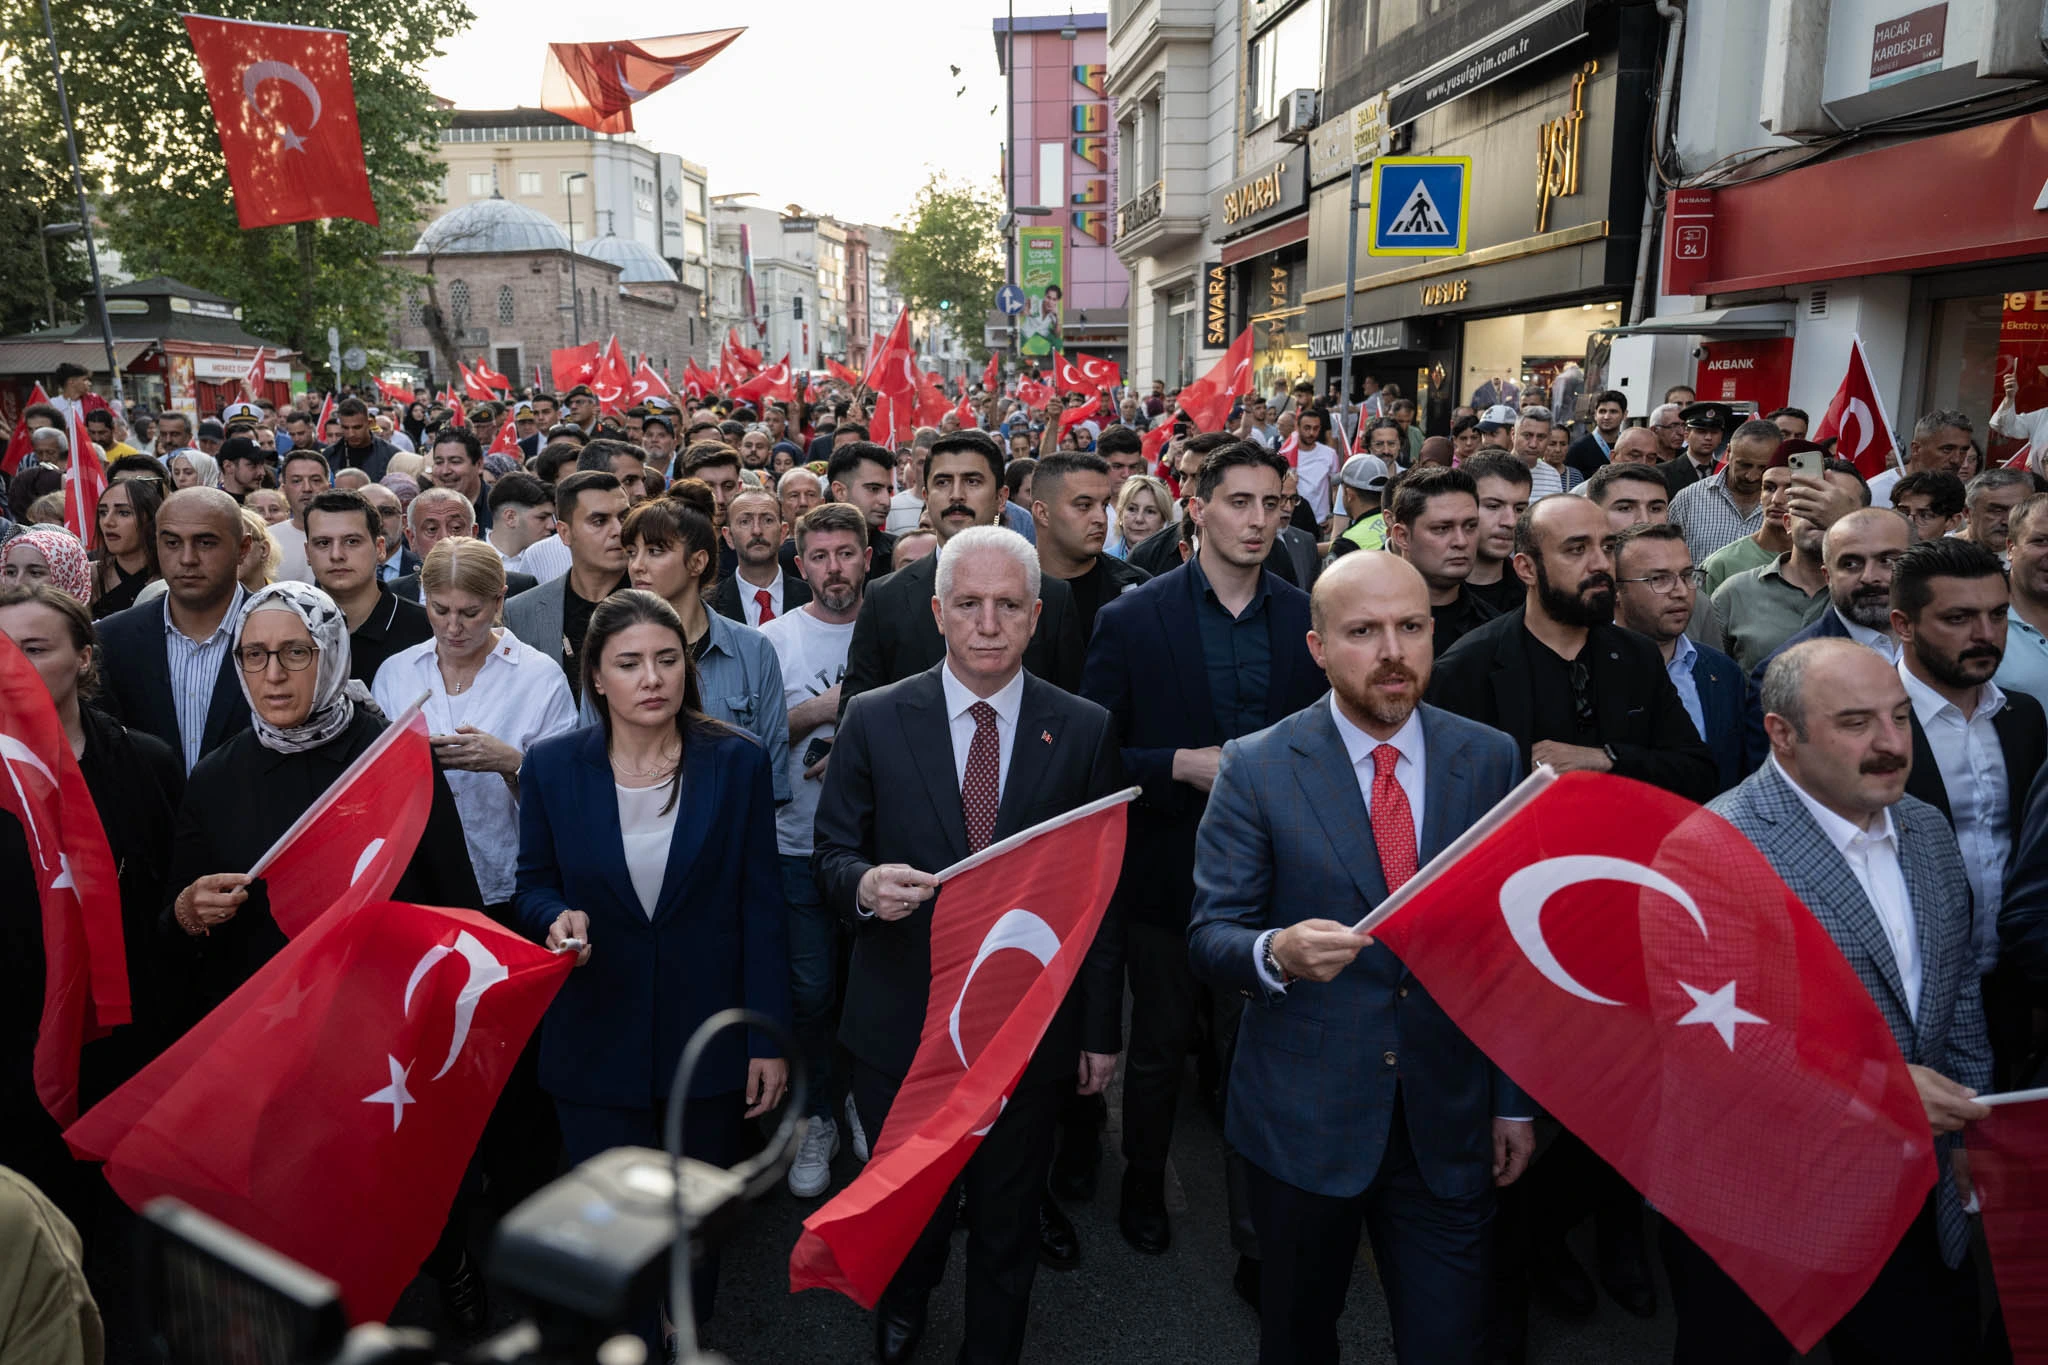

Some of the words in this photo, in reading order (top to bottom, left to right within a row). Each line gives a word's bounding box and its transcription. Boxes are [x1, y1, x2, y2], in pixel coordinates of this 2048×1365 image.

[1875, 20, 1911, 44] MACAR
[1873, 32, 1934, 63] KARDEŞLER
[1426, 37, 1530, 101] www.yusufgiyim.com.tr
[1684, 244, 1697, 255] 24
[1207, 266, 1226, 344] SAVARA
[2007, 321, 2039, 331] Ekstra
[1309, 332, 1345, 357] SULTAN
[1352, 324, 1384, 352] ASAJI
[1708, 358, 1755, 371] AKBANK
